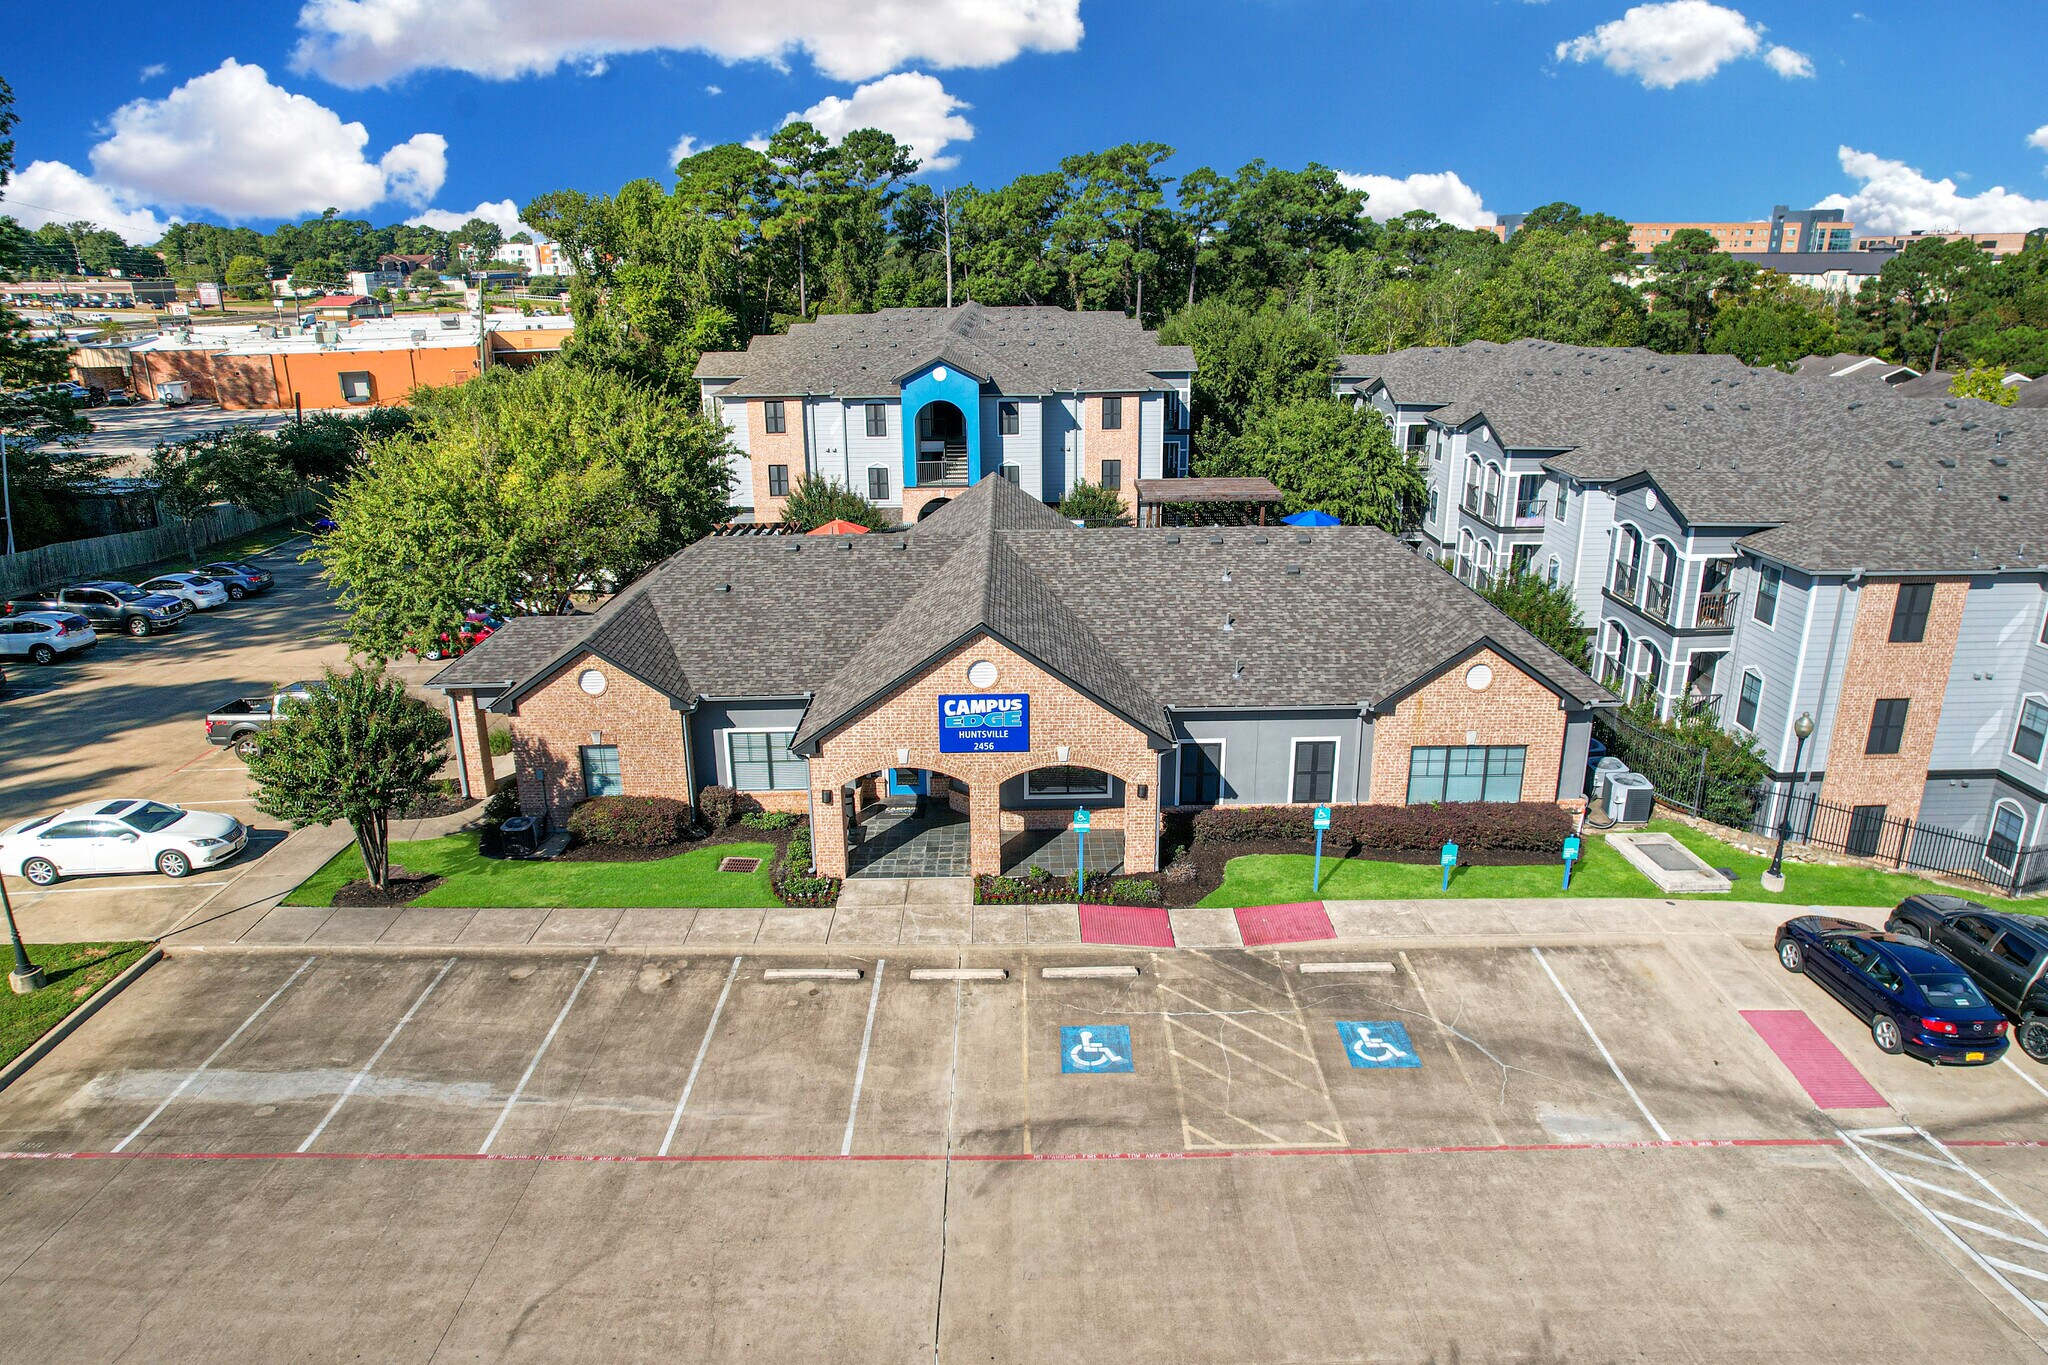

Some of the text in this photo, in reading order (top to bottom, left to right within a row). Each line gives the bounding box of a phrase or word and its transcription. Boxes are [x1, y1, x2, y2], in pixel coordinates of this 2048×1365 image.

[944, 698, 1023, 716] CAMPUS
[945, 710, 1022, 728] EDGE
[958, 729, 1009, 739] HUNTSVILLE
[973, 742, 995, 751] 2456
